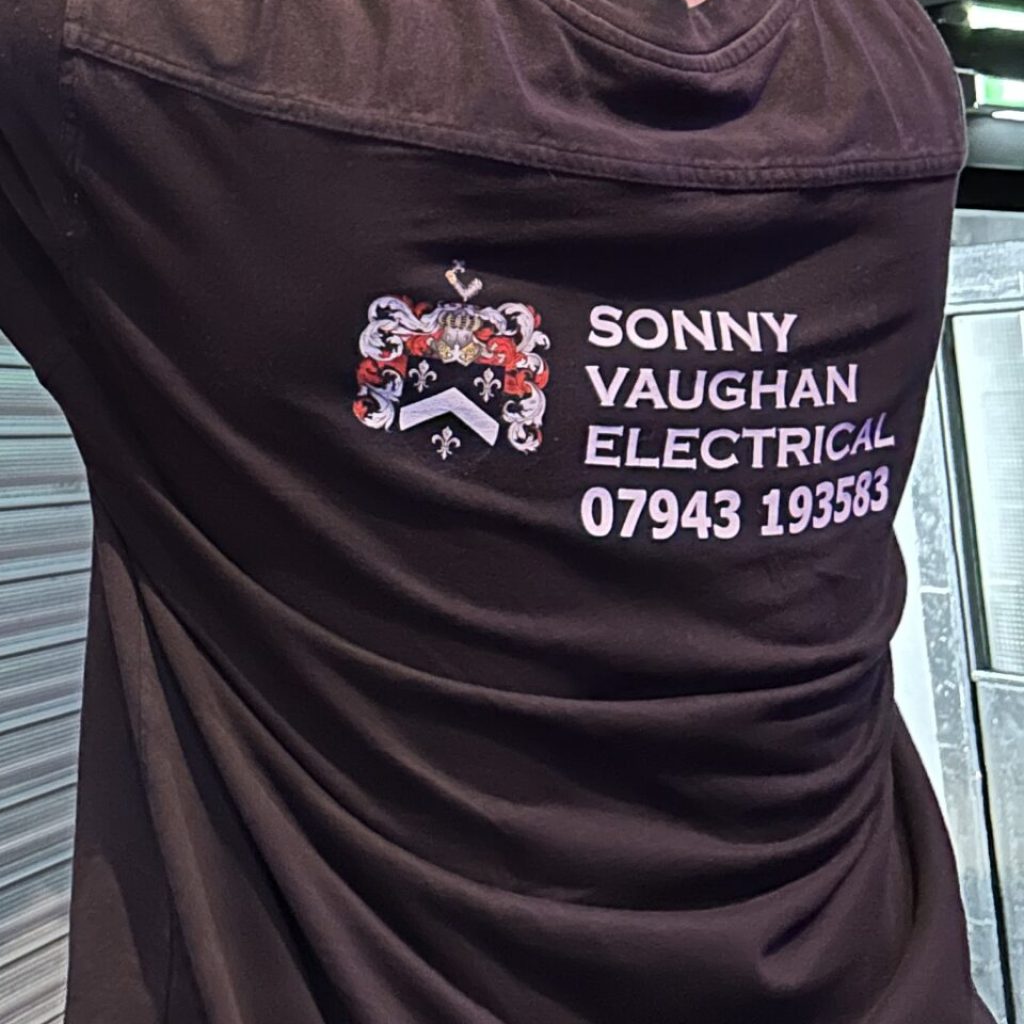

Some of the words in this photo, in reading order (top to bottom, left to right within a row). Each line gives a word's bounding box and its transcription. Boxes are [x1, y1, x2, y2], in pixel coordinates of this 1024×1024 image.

[588, 305, 798, 352] SONNY
[585, 364, 858, 410] VAUGHAN
[584, 412, 896, 470] ELECTRICAL
[580, 486, 741, 540] 07943
[761, 465, 890, 536] 193583
